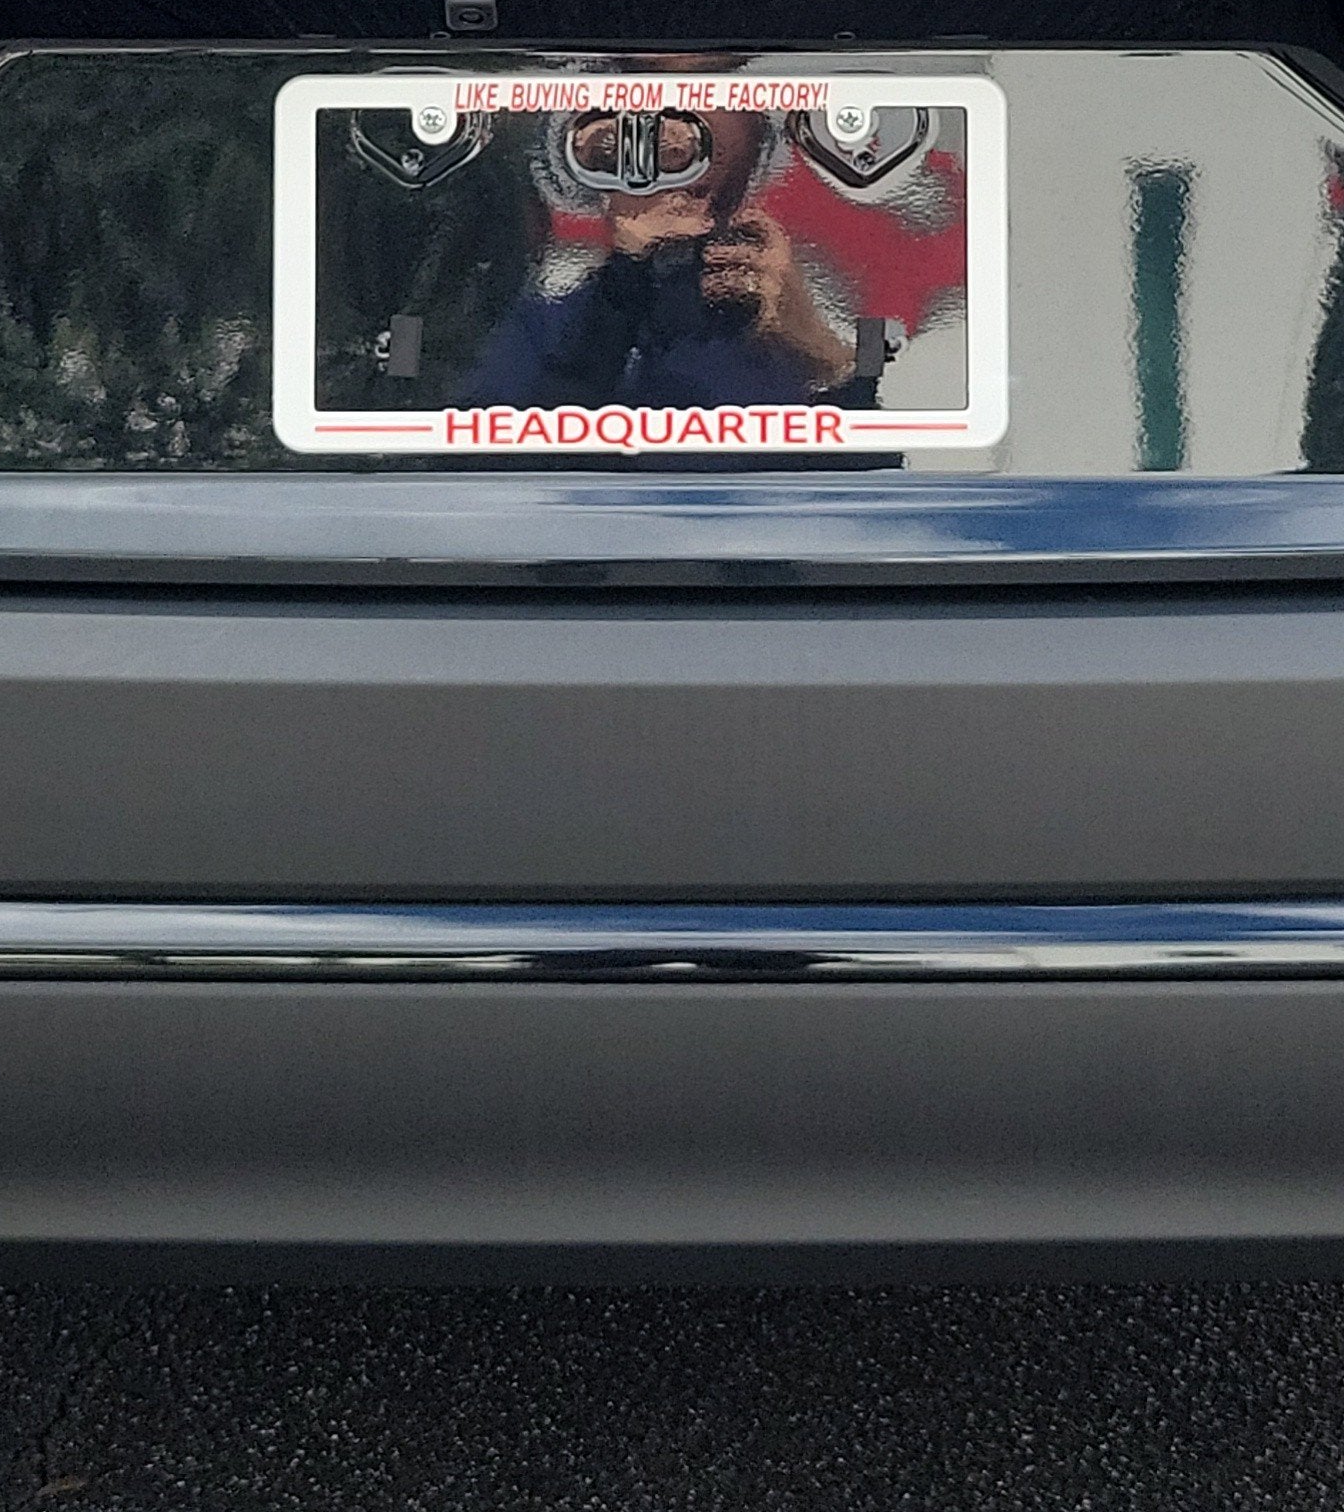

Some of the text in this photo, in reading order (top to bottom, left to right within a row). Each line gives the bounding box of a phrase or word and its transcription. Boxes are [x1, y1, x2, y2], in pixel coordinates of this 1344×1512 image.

[455, 82, 829, 110] LIKE BUYING FROM THE FACTORY!
[445, 411, 846, 448] HEADQUARTER
